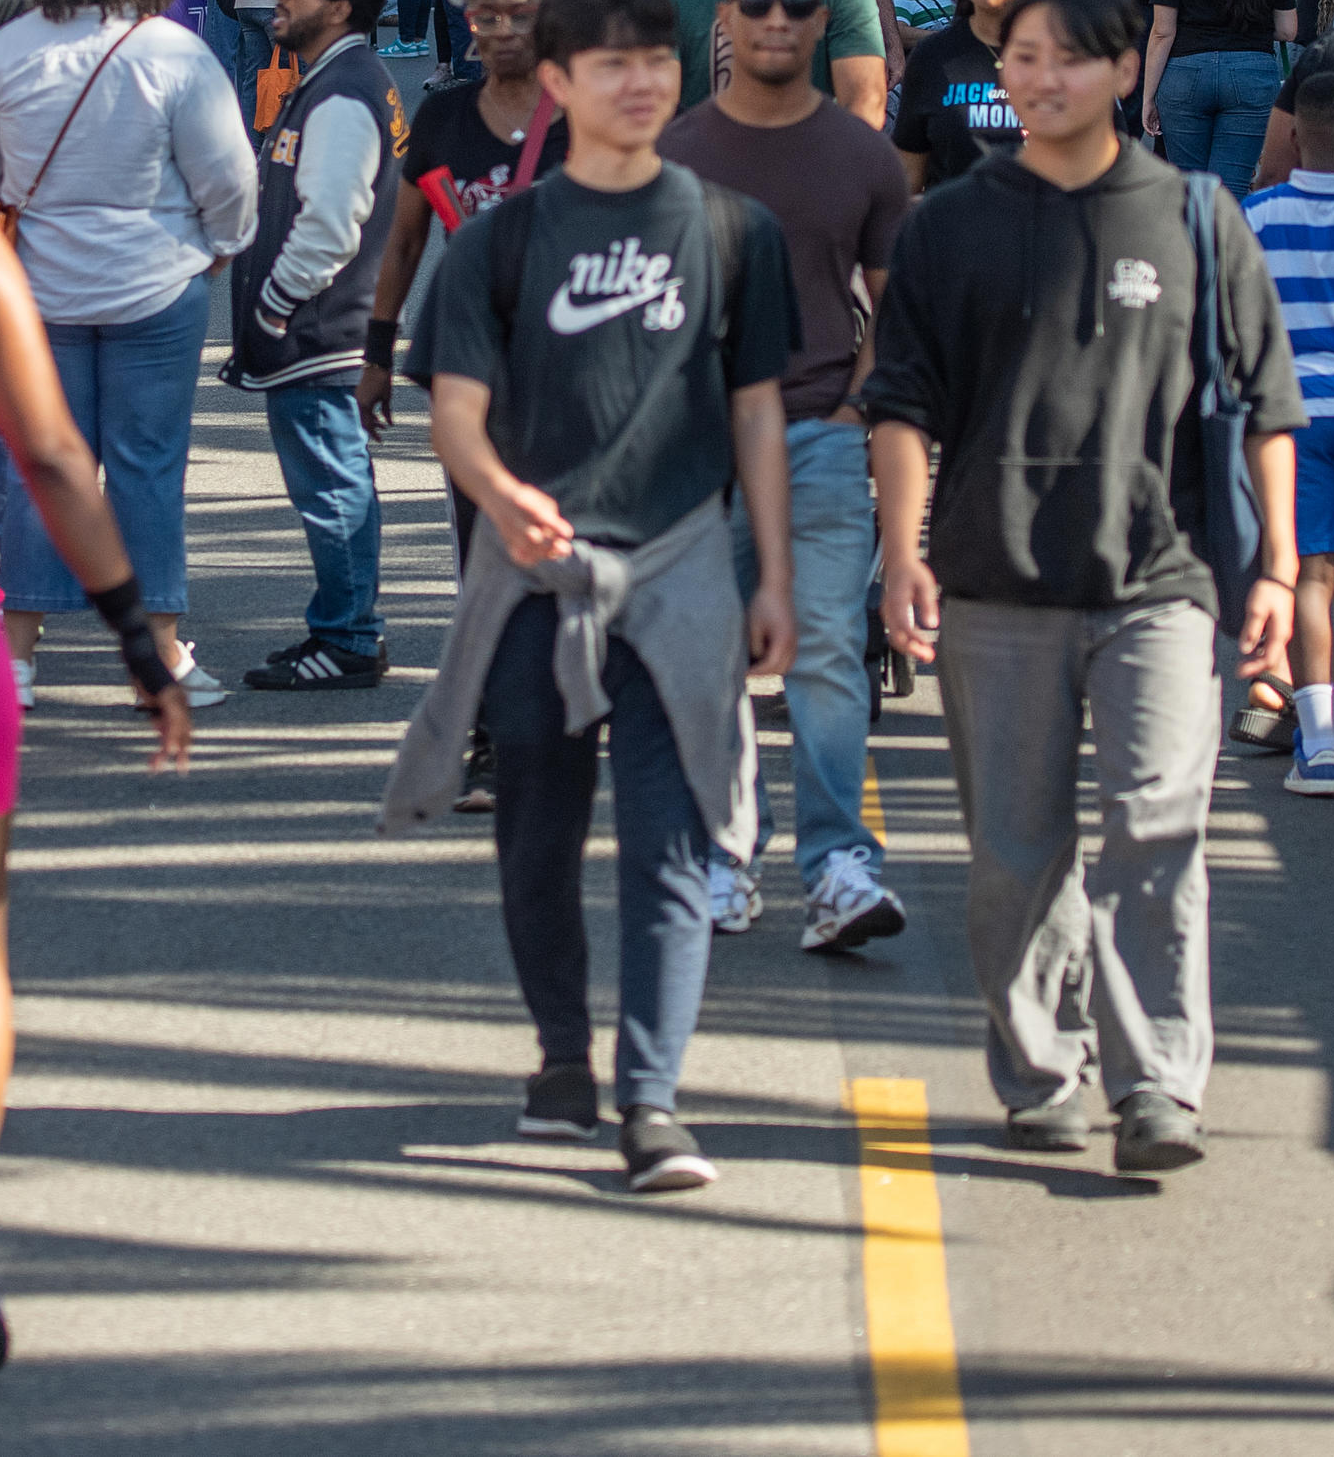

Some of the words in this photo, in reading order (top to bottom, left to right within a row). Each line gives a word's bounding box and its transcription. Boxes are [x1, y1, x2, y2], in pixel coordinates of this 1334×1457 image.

[942, 82, 995, 106] JACK
[987, 88, 1010, 99] an
[569, 236, 672, 295] nike
[642, 286, 686, 331] sb
